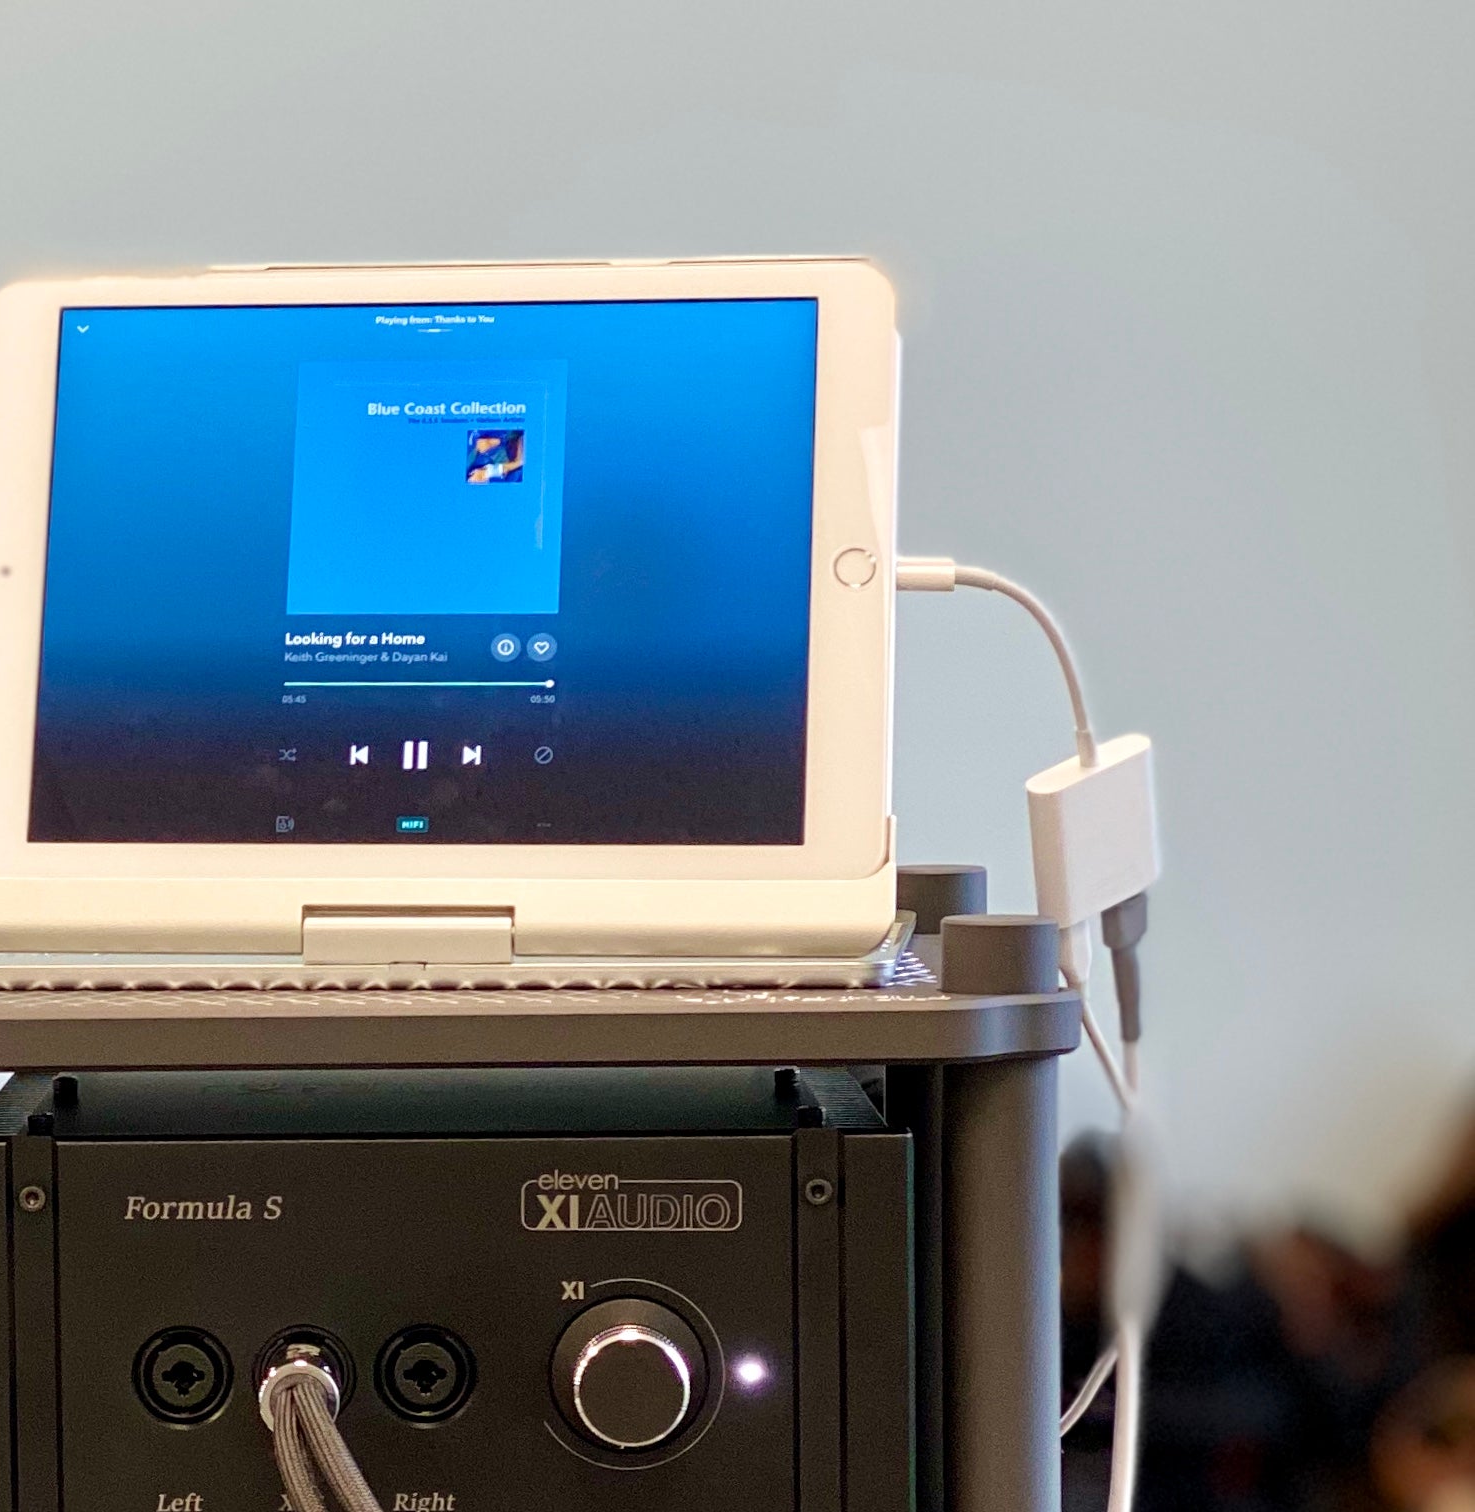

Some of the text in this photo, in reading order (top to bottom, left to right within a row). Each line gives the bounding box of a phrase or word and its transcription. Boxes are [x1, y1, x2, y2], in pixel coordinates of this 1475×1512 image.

[375, 315, 408, 326] Playing
[434, 315, 465, 324] Thanks
[467, 316, 476, 324] to
[478, 315, 495, 323] You
[368, 401, 526, 415] Blue Coast Collection
[284, 631, 425, 648] Looking for a Home
[284, 651, 448, 665] Keith Greeninger & Dayan Kai
[537, 1169, 619, 1191] eleven
[124, 1194, 283, 1220] Formula S
[560, 1280, 585, 1301] XI
[156, 1493, 204, 1512] Left
